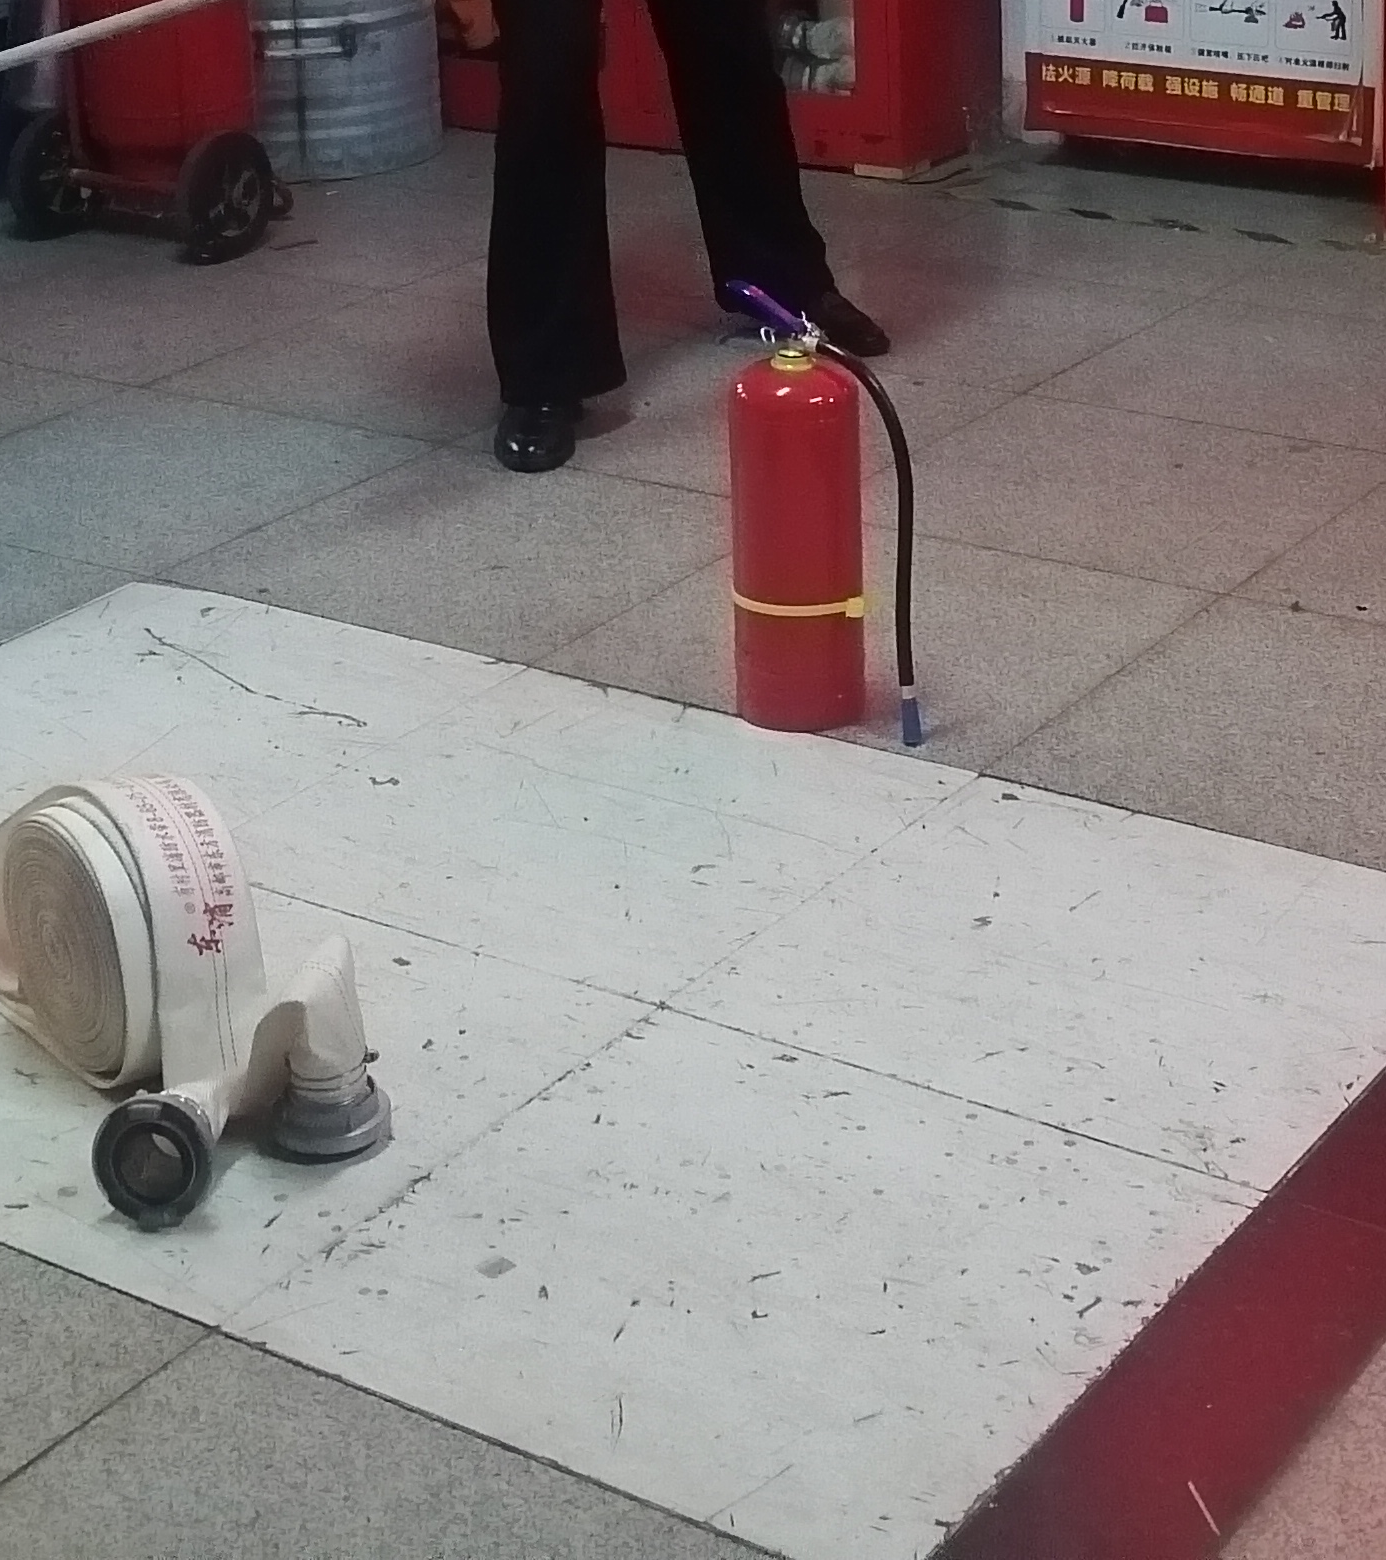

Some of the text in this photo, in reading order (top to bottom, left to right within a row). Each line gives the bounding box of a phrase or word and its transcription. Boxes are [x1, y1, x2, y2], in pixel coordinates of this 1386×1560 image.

[1102, 68, 1154, 92] 降荷载
[1165, 75, 1219, 100] 强设施
[1229, 82, 1284, 106] 畅通道
[1297, 89, 1351, 113] 重管理
